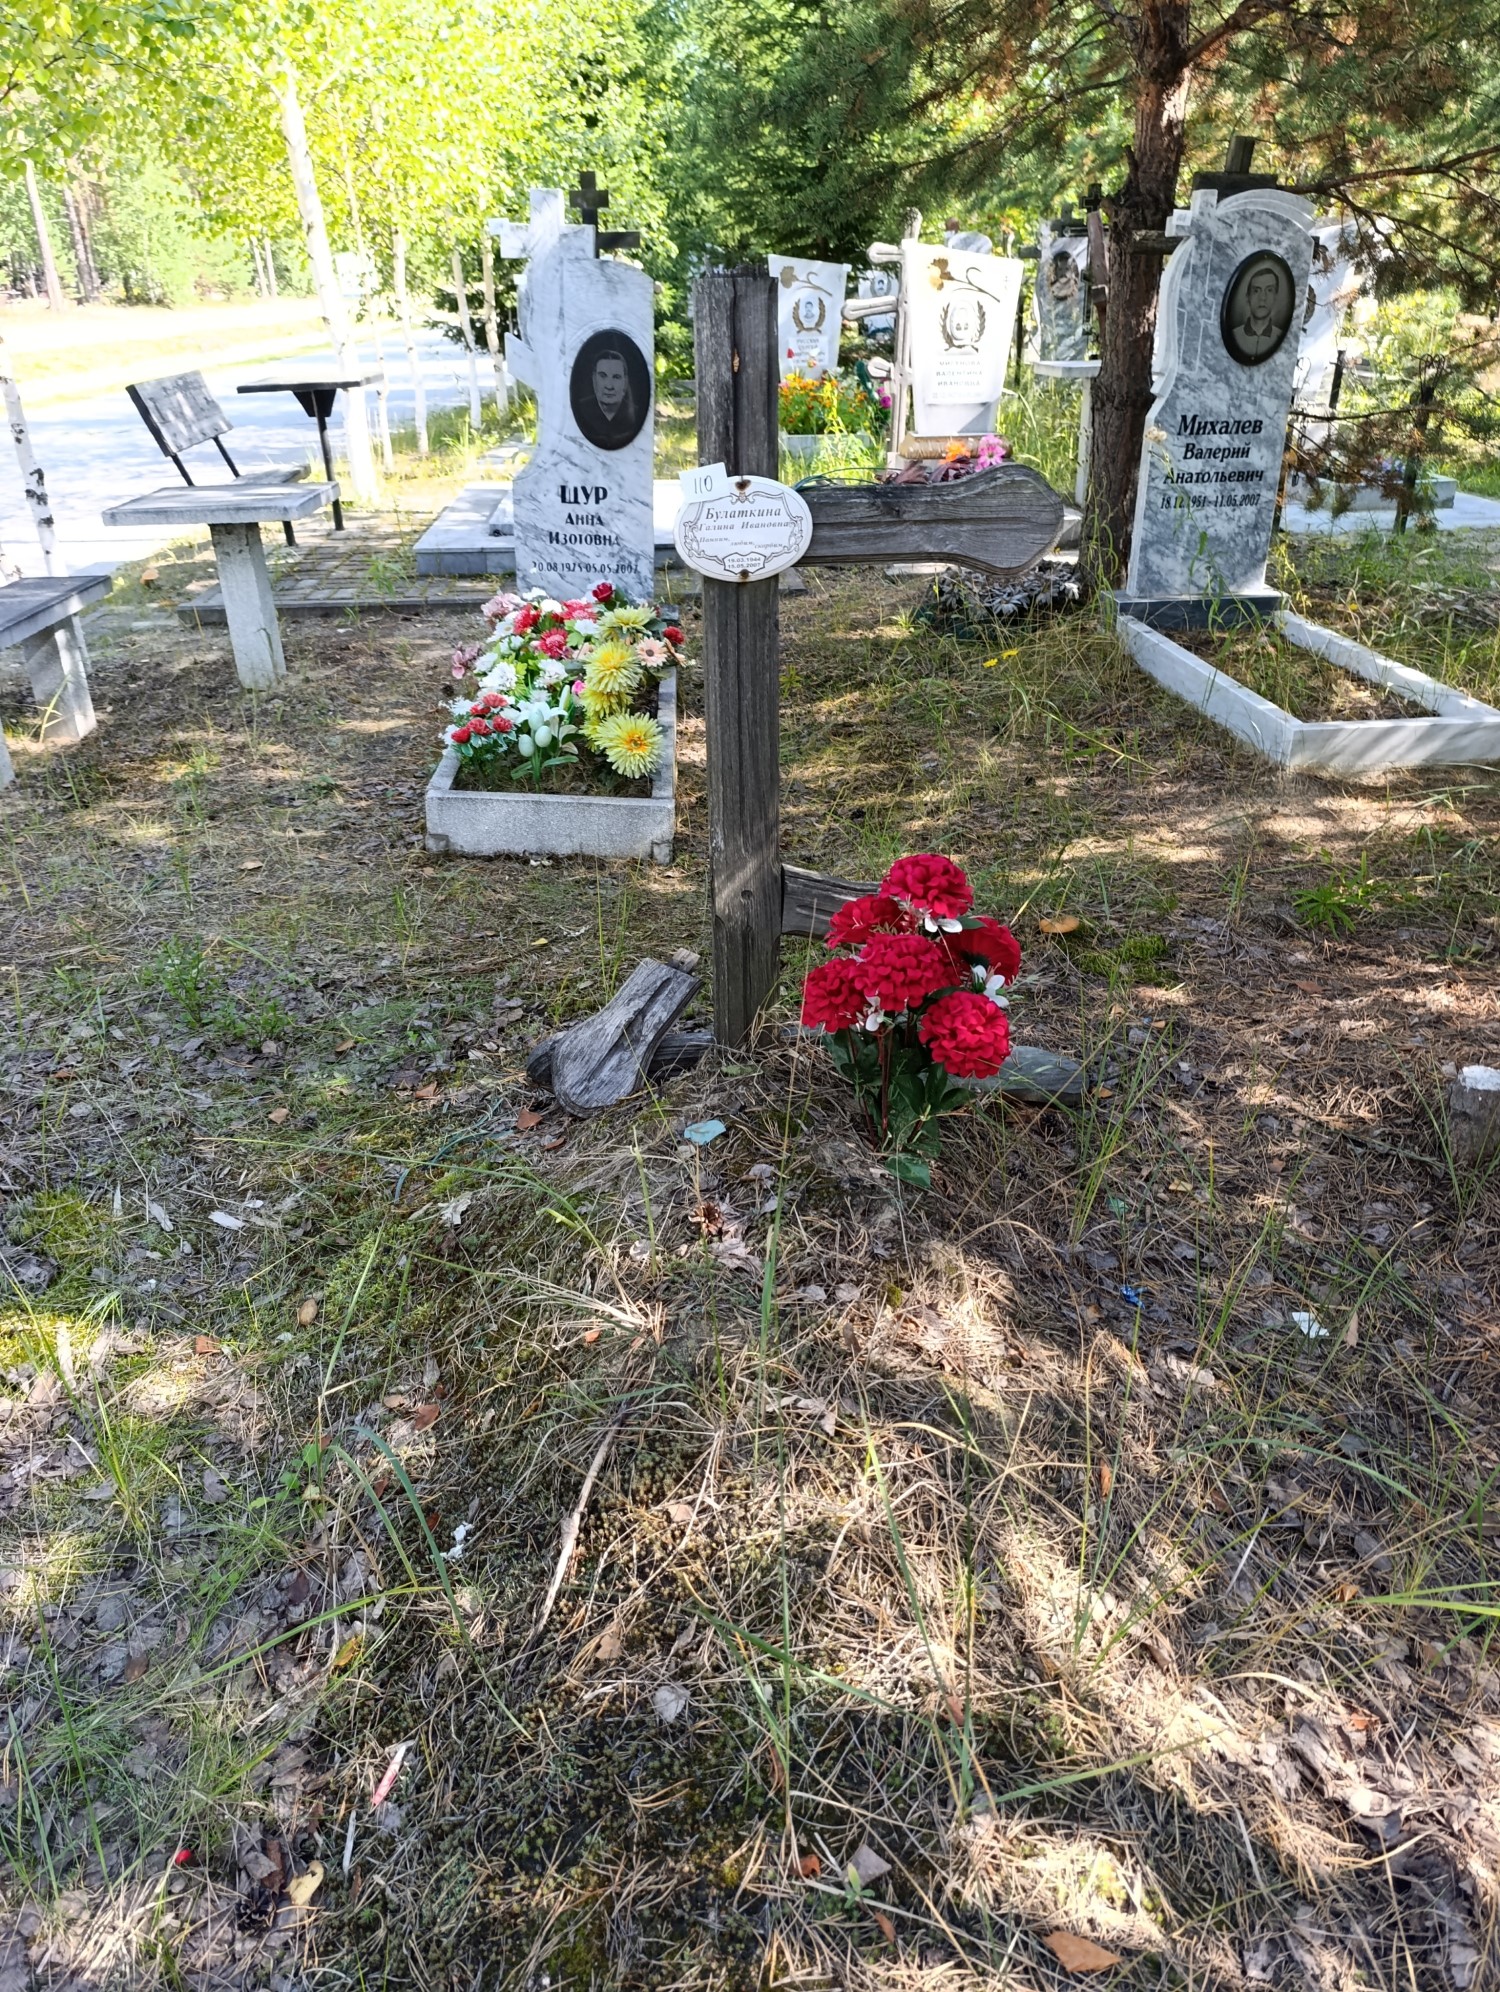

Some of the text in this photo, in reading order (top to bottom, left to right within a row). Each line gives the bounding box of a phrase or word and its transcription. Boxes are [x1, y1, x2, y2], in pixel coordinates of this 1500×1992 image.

[1177, 414, 1263, 436] Михалев
[1183, 442, 1251, 462] Валерий
[1163, 467, 1264, 485] Анатольевич
[694, 475, 713, 494] 110
[560, 485, 608, 505] ЩУР
[1214, 493, 1261, 508] 11.05.2007
[565, 512, 605, 526] АННА
[705, 507, 782, 522] Булаткина
[699, 521, 789, 531] Галина Ивановна
[549, 531, 621, 546] ИЗОТОВНА
